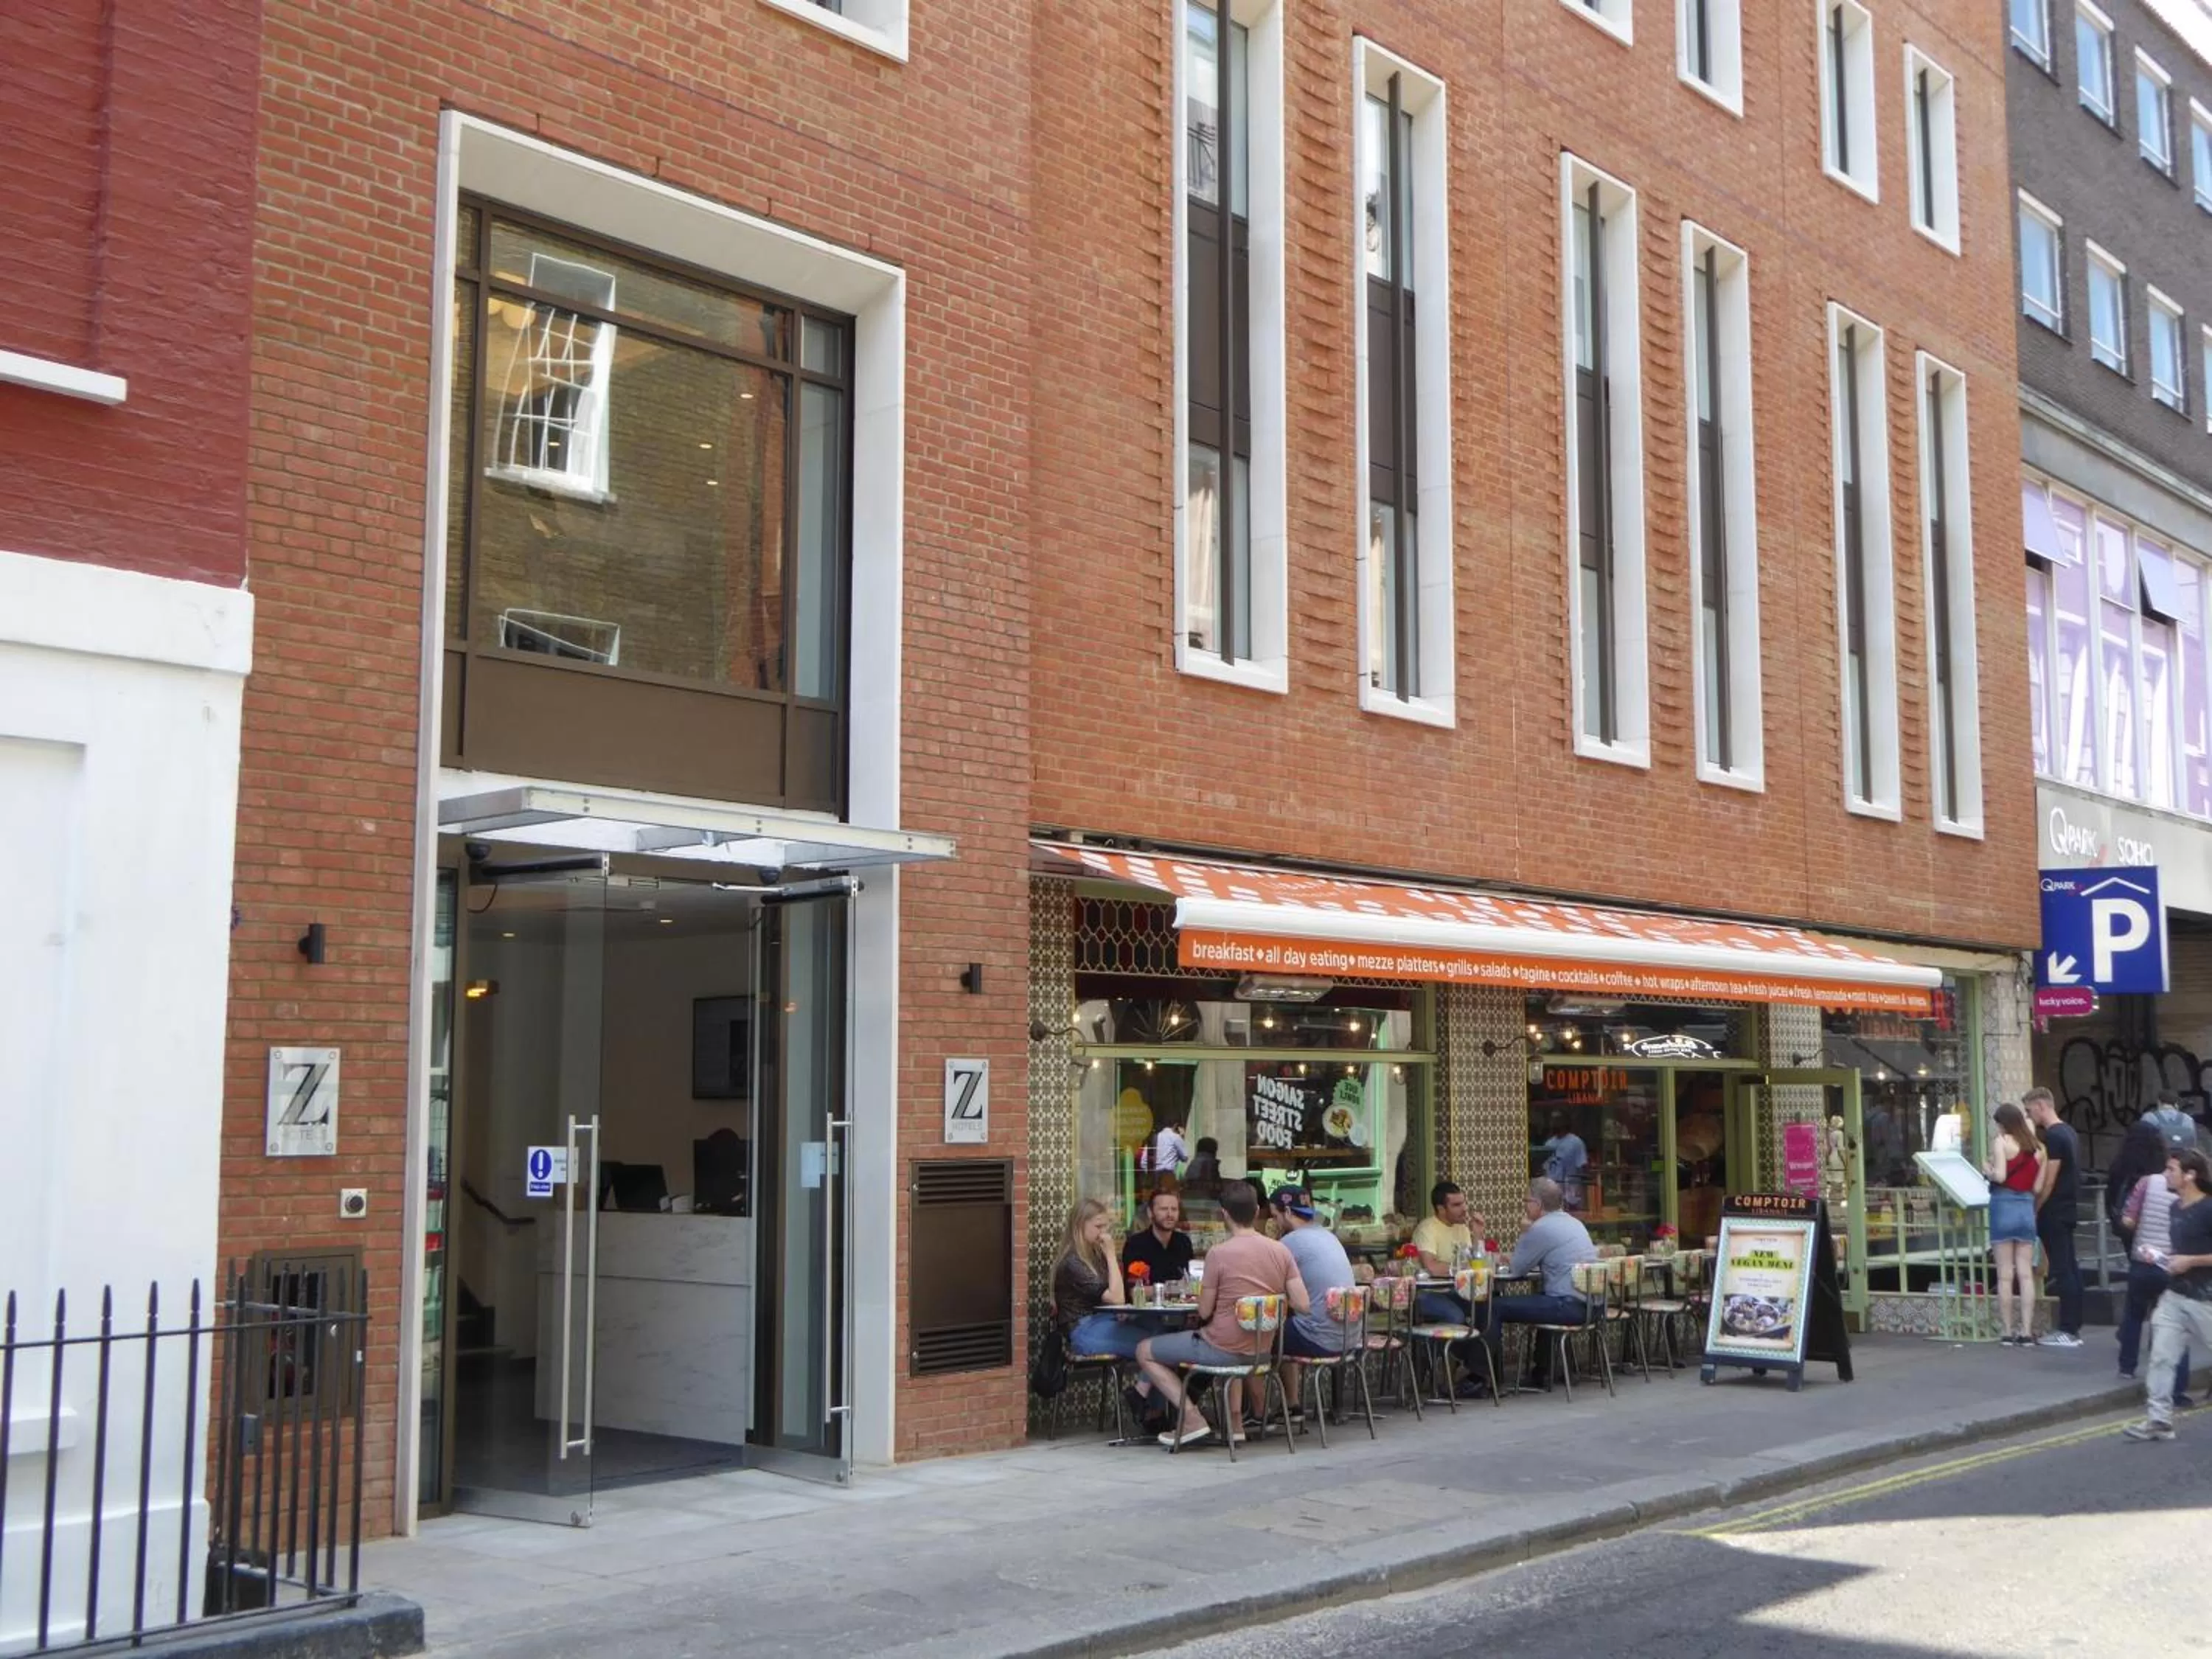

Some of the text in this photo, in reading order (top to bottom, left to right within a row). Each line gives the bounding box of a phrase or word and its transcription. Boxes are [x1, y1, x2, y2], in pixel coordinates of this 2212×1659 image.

[2118, 837, 2154, 866] SOHO
[2092, 898, 2150, 982] P
[1192, 939, 1255, 962] breakfast
[1265, 945, 1280, 964] all
[1283, 947, 1306, 968] day
[1309, 949, 1348, 971] eating
[1357, 955, 1394, 970] mezze
[1397, 955, 1439, 973] platters
[1446, 958, 1472, 978] grills
[1480, 961, 1511, 978] salads
[1520, 964, 1550, 983] tagine
[1557, 969, 1599, 985] cocktails
[1605, 970, 1634, 987] coffee
[1642, 974, 1658, 989] hot
[1660, 977, 1685, 991] wraps
[277, 1062, 330, 1125] Z
[951, 1071, 983, 1119] Z
[1546, 1068, 1628, 1091] COMPTOIR
[1734, 1195, 1806, 1209] COMPTOIR
